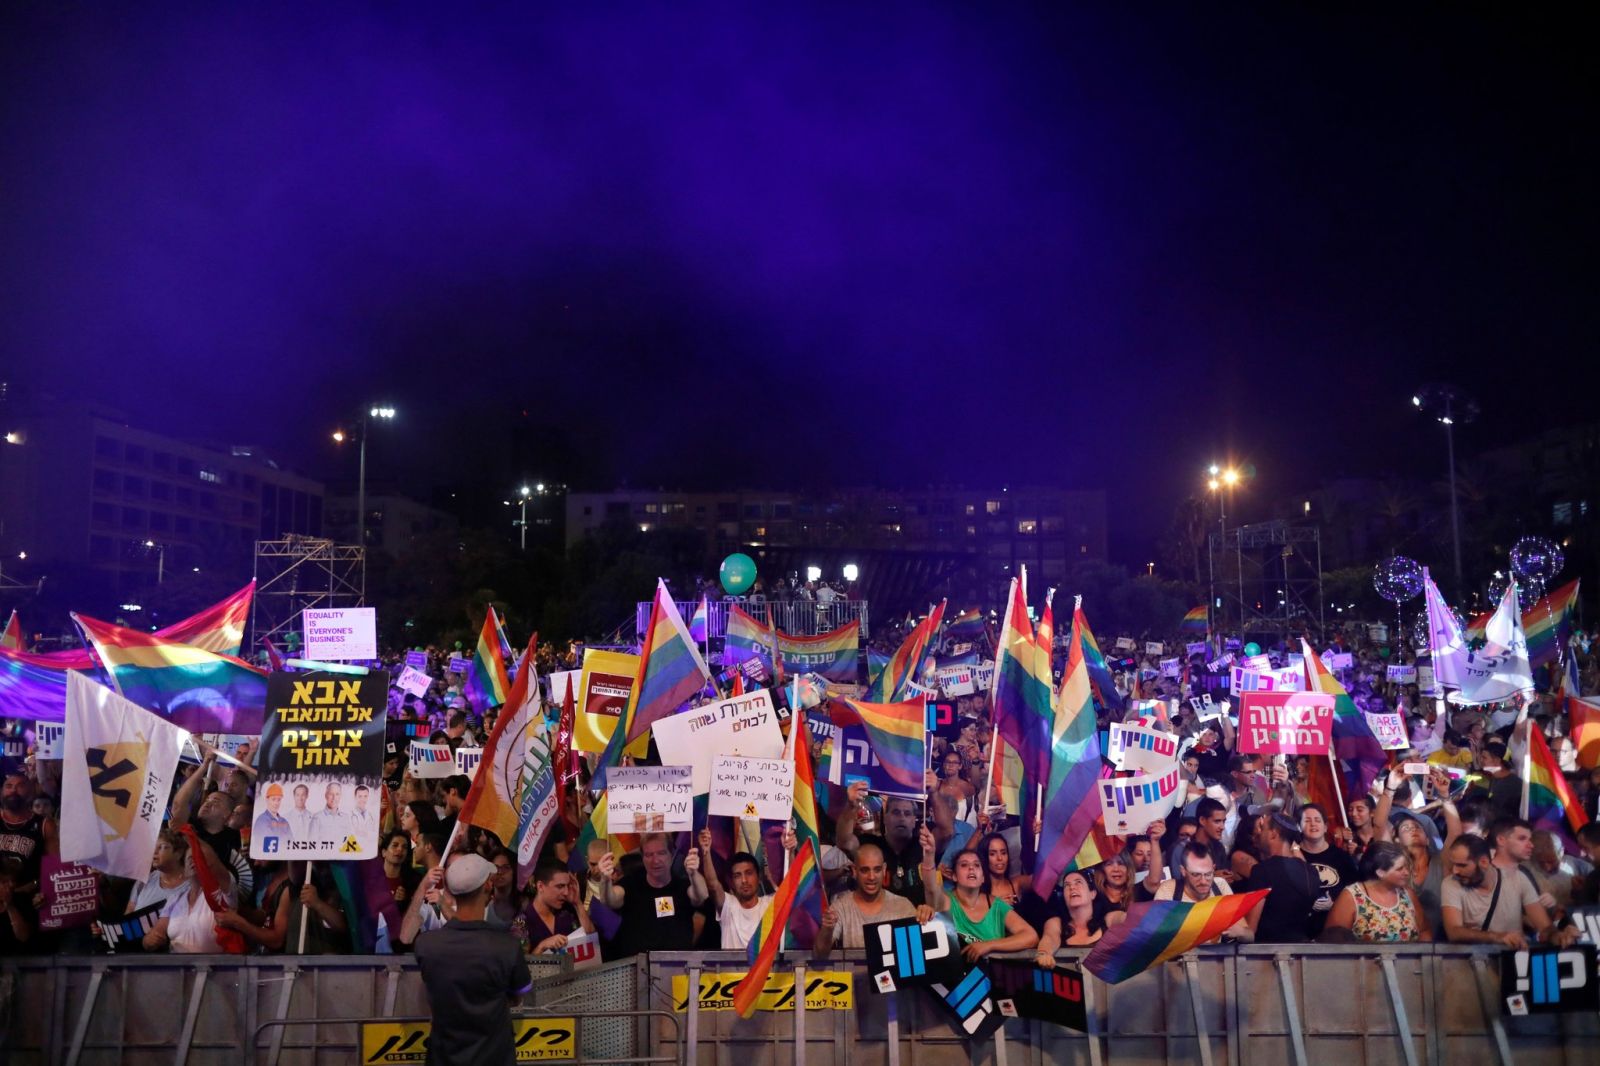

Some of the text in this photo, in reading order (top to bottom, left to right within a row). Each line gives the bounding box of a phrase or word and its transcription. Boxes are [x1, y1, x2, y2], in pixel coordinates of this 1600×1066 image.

[791, 653, 835, 664] שנברא
[1466, 667, 1491, 677] לפיד
[941, 673, 969, 690] שוויון!
[290, 681, 361, 705] אבא
[277, 705, 373, 722] אל תתאבד
[733, 712, 767, 732] לכולם
[1249, 705, 1318, 726] גאווה
[688, 713, 717, 732] שווה
[282, 730, 364, 748] צריכים
[1113, 728, 1175, 757] שוויון!
[1251, 728, 1324, 749] רמת גן
[291, 748, 350, 769] אותך
[410, 744, 451, 766] שוויון!
[719, 760, 749, 770] להיות
[1104, 769, 1178, 815] שוויון!
[663, 802, 687, 814] מתי
[287, 840, 316, 850] אבא!
[321, 841, 334, 850] זה
[57, 880, 94, 891] נכנעים
[52, 901, 95, 915] לאפליה
[516, 1050, 544, 1058] לארוע
